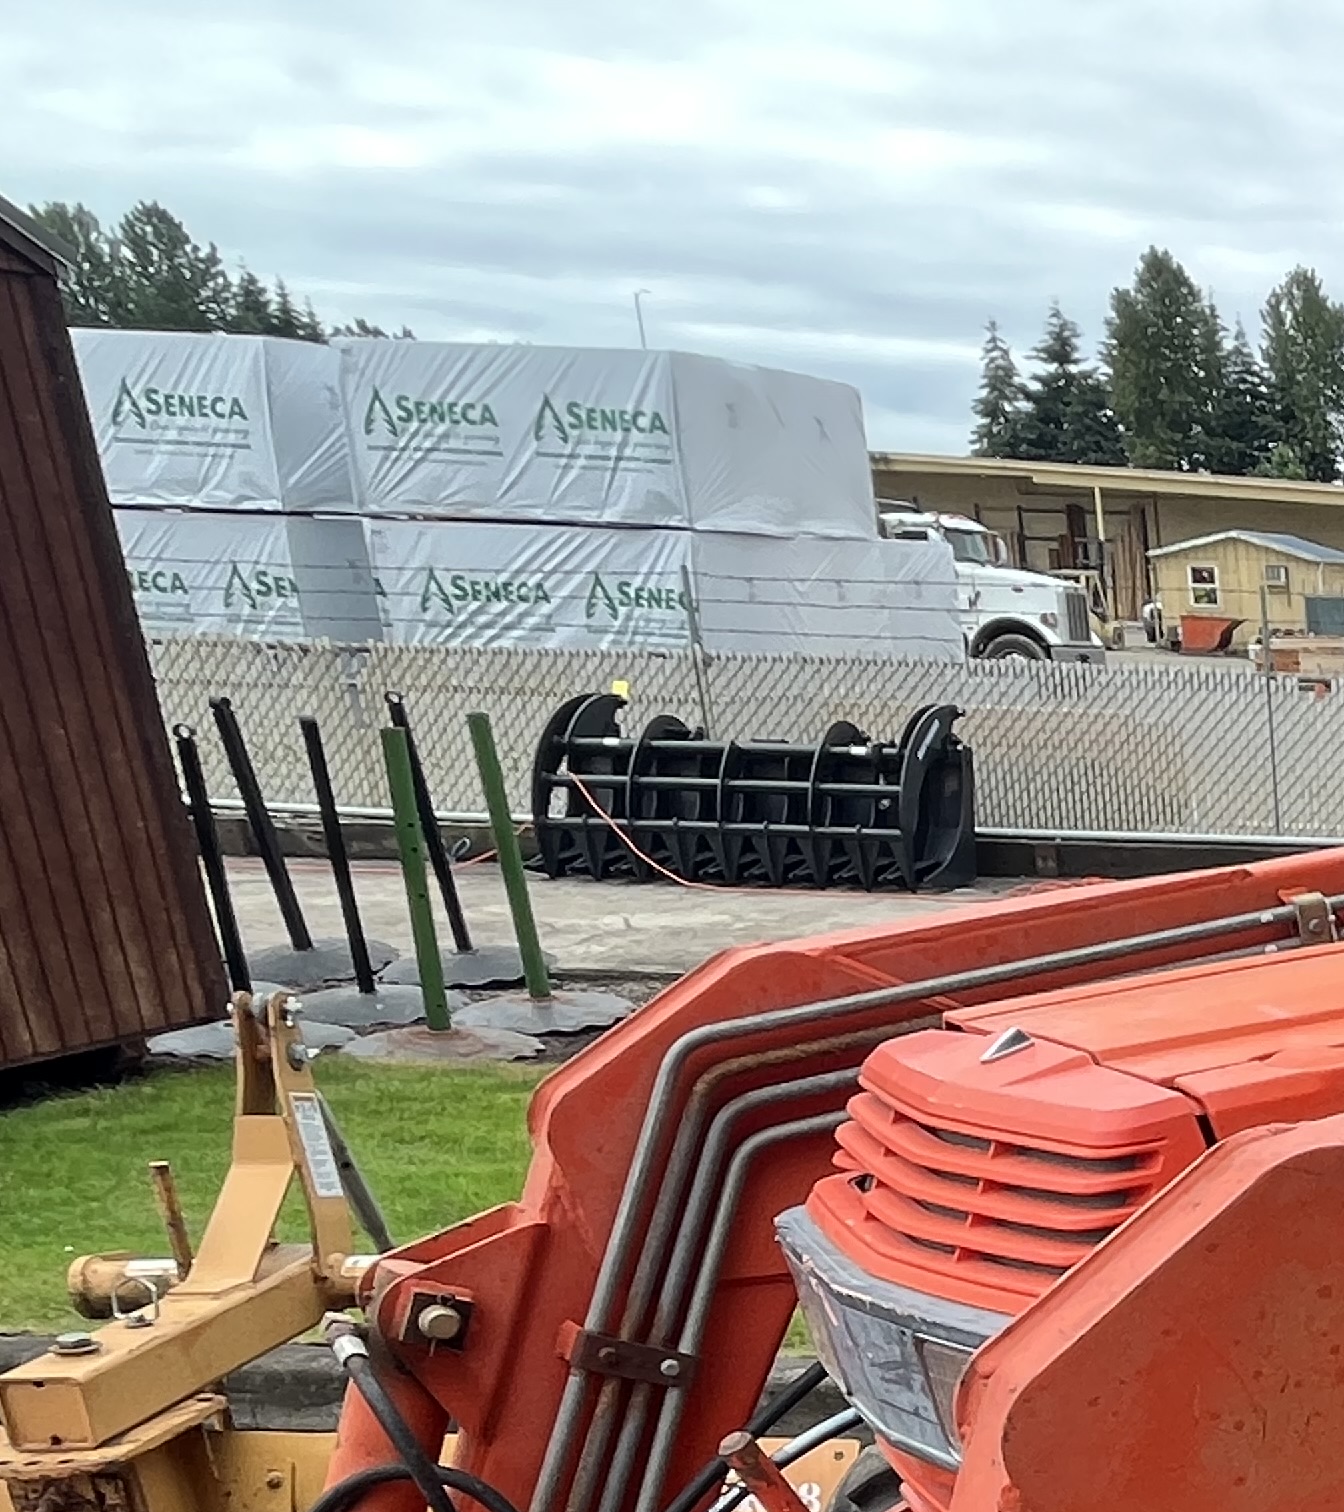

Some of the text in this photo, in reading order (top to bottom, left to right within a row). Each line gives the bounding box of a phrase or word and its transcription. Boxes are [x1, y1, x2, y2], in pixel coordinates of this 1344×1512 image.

[144, 387, 249, 421] SENECA
[395, 395, 498, 427] SENECA
[565, 401, 670, 435] SENECA
[451, 574, 551, 604] SENECA
